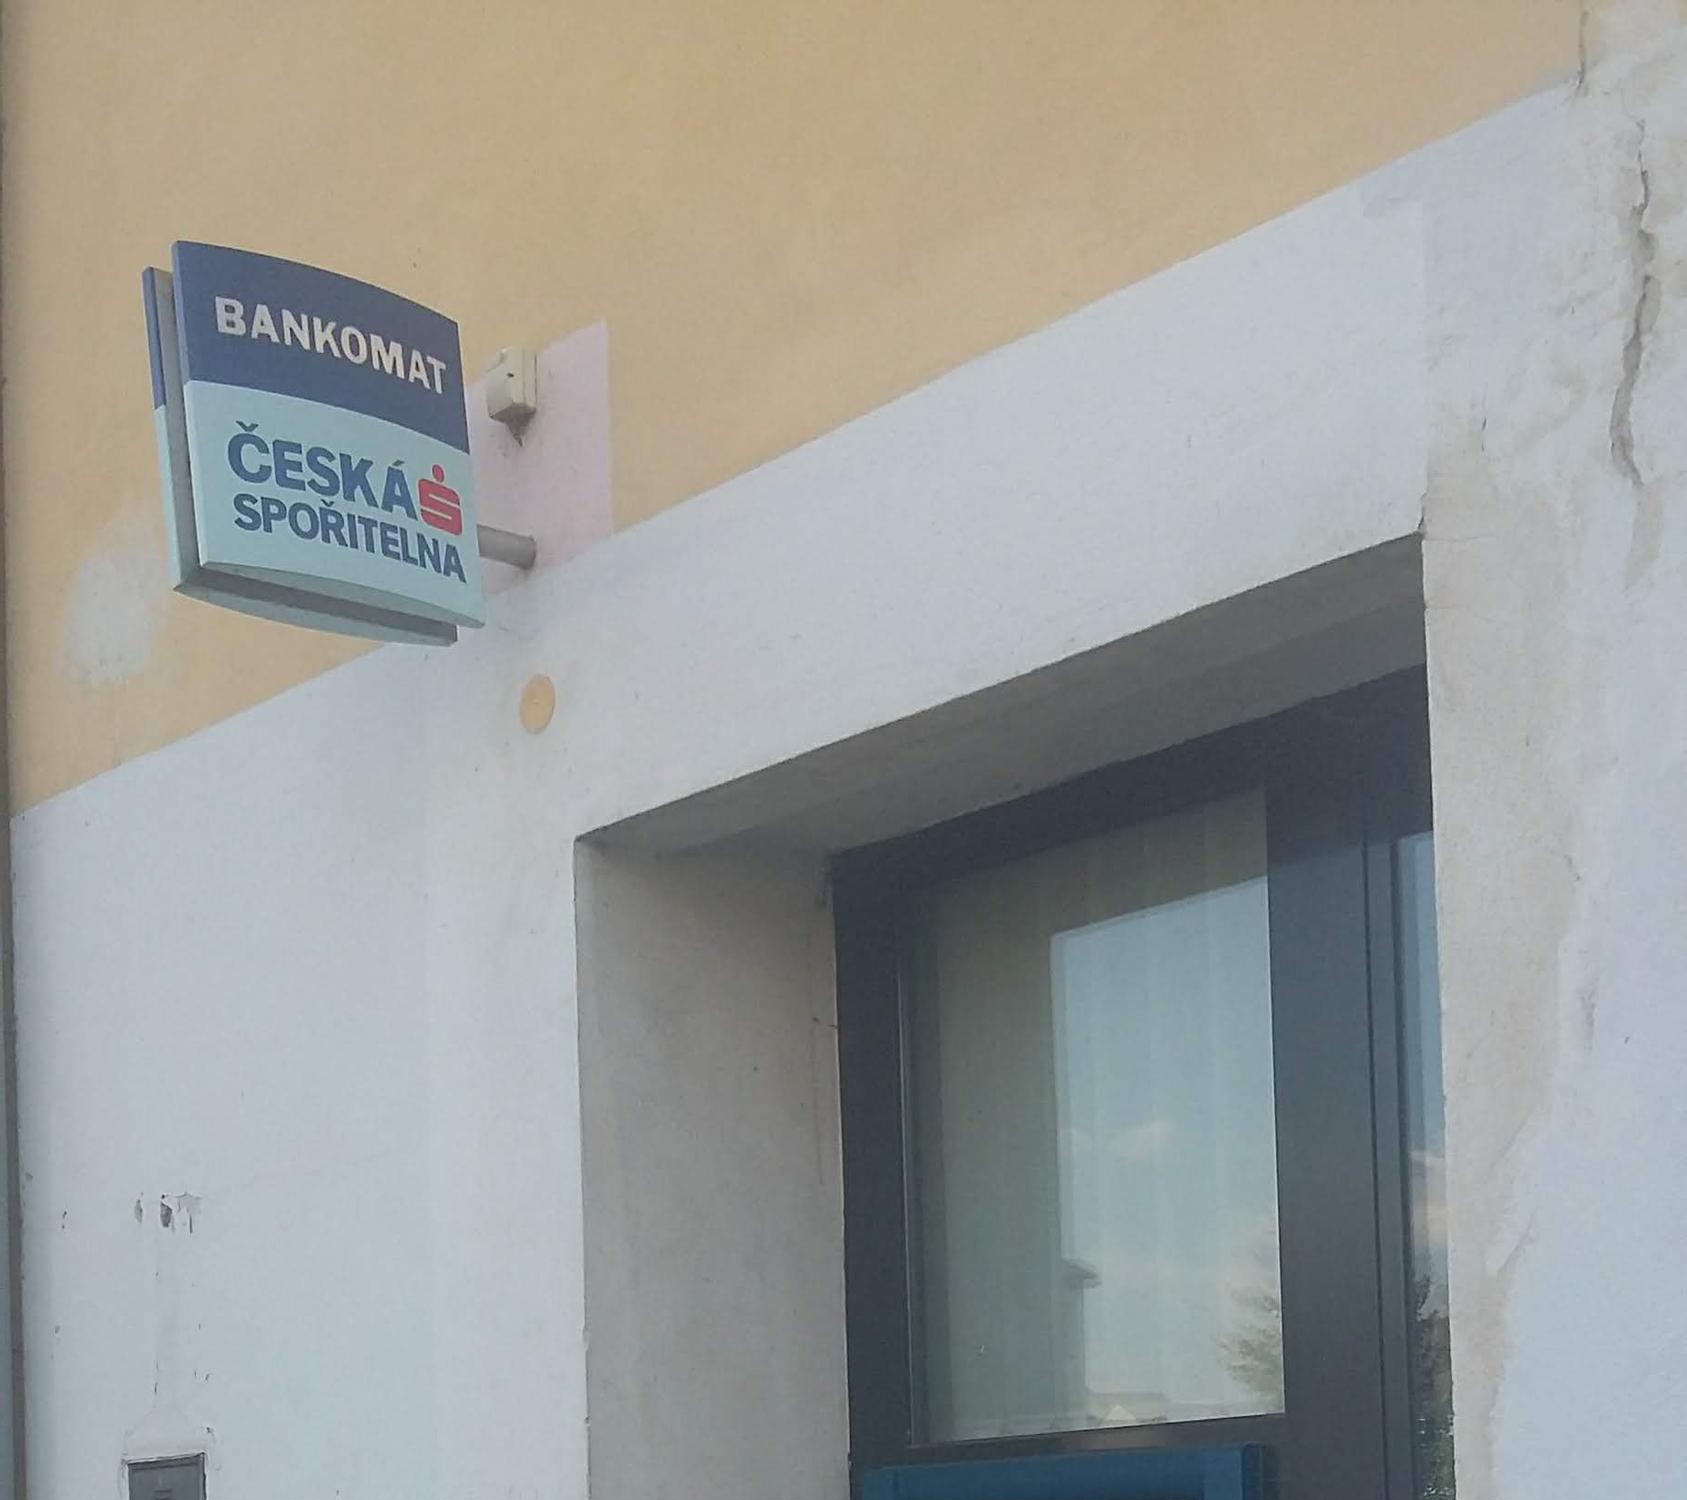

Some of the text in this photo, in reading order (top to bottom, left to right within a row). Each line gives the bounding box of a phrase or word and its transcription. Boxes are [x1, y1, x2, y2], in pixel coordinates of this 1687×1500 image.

[214, 295, 447, 395] BANKOMAT
[227, 420, 418, 521] ČESKÁ
[233, 493, 467, 583] SPOŘITELNA
